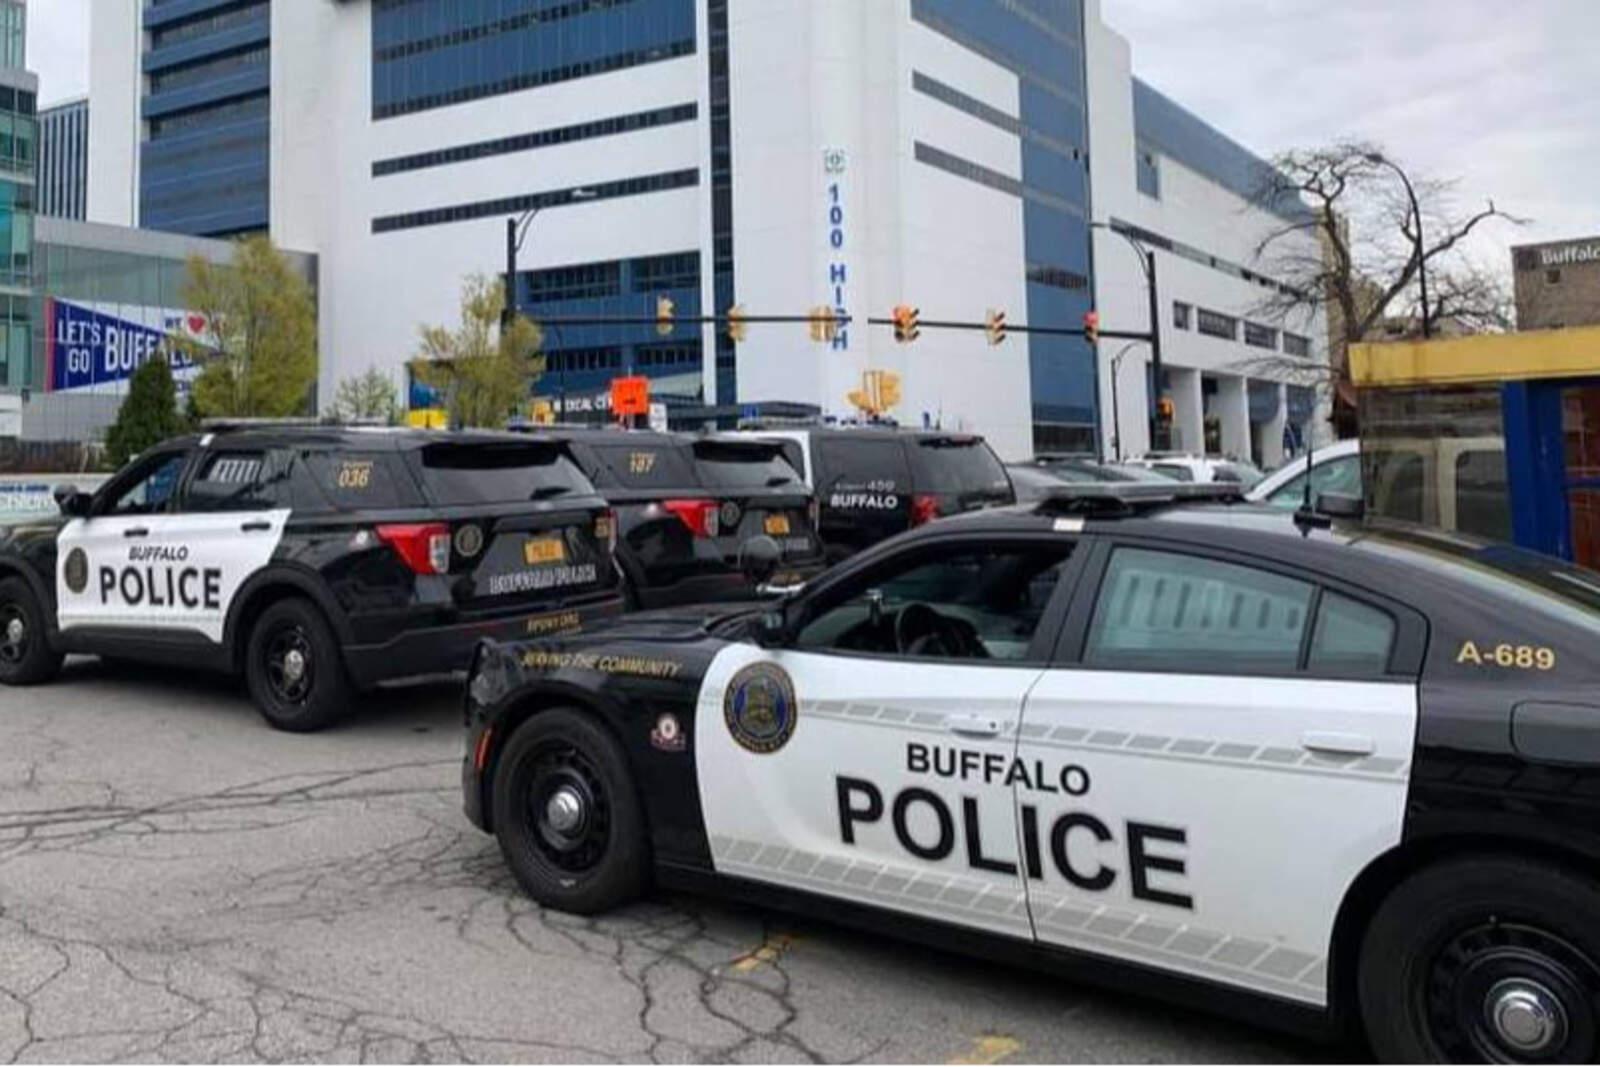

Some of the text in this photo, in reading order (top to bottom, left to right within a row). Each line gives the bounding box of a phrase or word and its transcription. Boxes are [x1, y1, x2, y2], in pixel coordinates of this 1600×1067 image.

[829, 183, 843, 248] 100
[58, 319, 101, 346] LET'S
[68, 348, 90, 374] GO
[831, 494, 898, 509] BUFFALO
[129, 546, 189, 561] BUFFALO
[100, 566, 221, 609] POLICE
[600, 655, 682, 677] COMMUNITY
[1456, 640, 1555, 670] A-689
[906, 743, 1091, 797] BUFFALO
[835, 775, 1194, 909] POLICE
